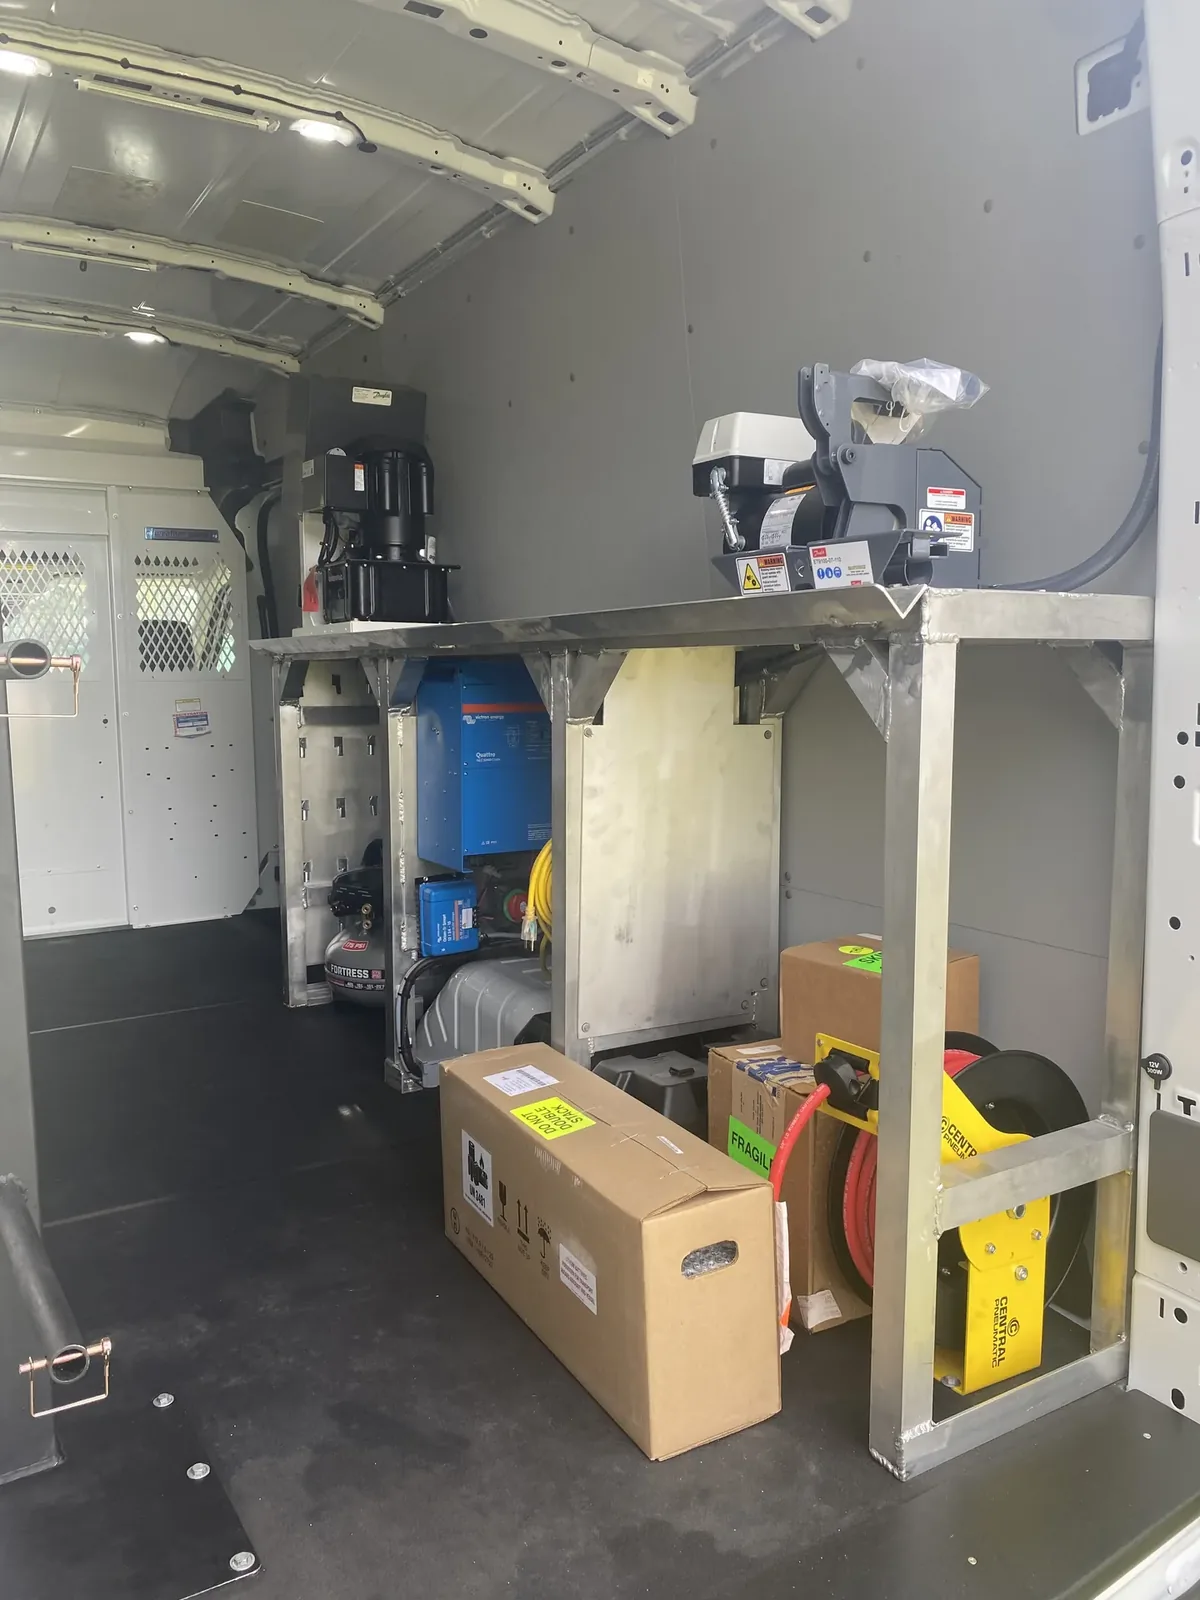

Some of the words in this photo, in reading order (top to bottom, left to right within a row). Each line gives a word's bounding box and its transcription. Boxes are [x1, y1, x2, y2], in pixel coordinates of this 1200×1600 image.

[952, 515, 972, 524] WARNING
[764, 557, 783, 565] WARNING
[331, 964, 369, 978] FORTRESS
[521, 1112, 544, 1125] NOT
[534, 1106, 572, 1130] DOUBLE
[551, 1104, 583, 1124] STACK
[539, 1124, 556, 1134] DO
[948, 1124, 977, 1158] CENTR
[732, 1131, 774, 1170] FRAGIL
[470, 1184, 476, 1199] UN
[998, 1296, 1008, 1366] CENTRAL
